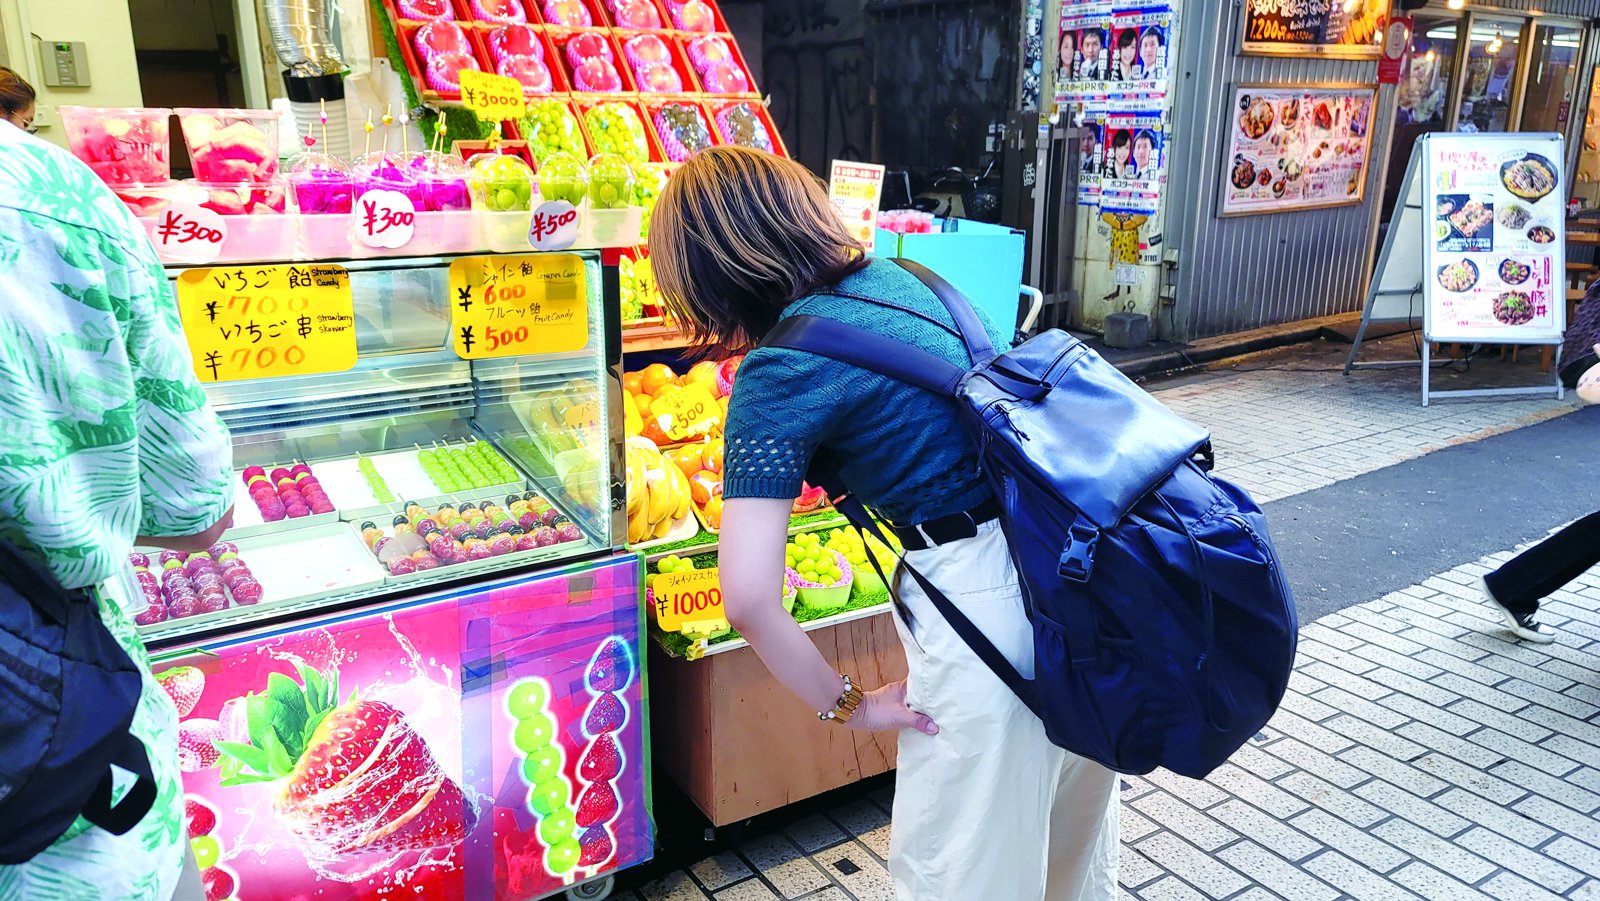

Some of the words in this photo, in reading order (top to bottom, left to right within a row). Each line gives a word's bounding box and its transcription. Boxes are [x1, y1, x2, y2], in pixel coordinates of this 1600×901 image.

[464, 86, 518, 108] ¥3000
[158, 210, 222, 244] ¥300
[363, 199, 414, 236] ¥300
[531, 210, 577, 241] ¥500
[460, 325, 529, 353] ¥500
[204, 345, 306, 381] ¥700
[656, 587, 722, 617] ¥1000
